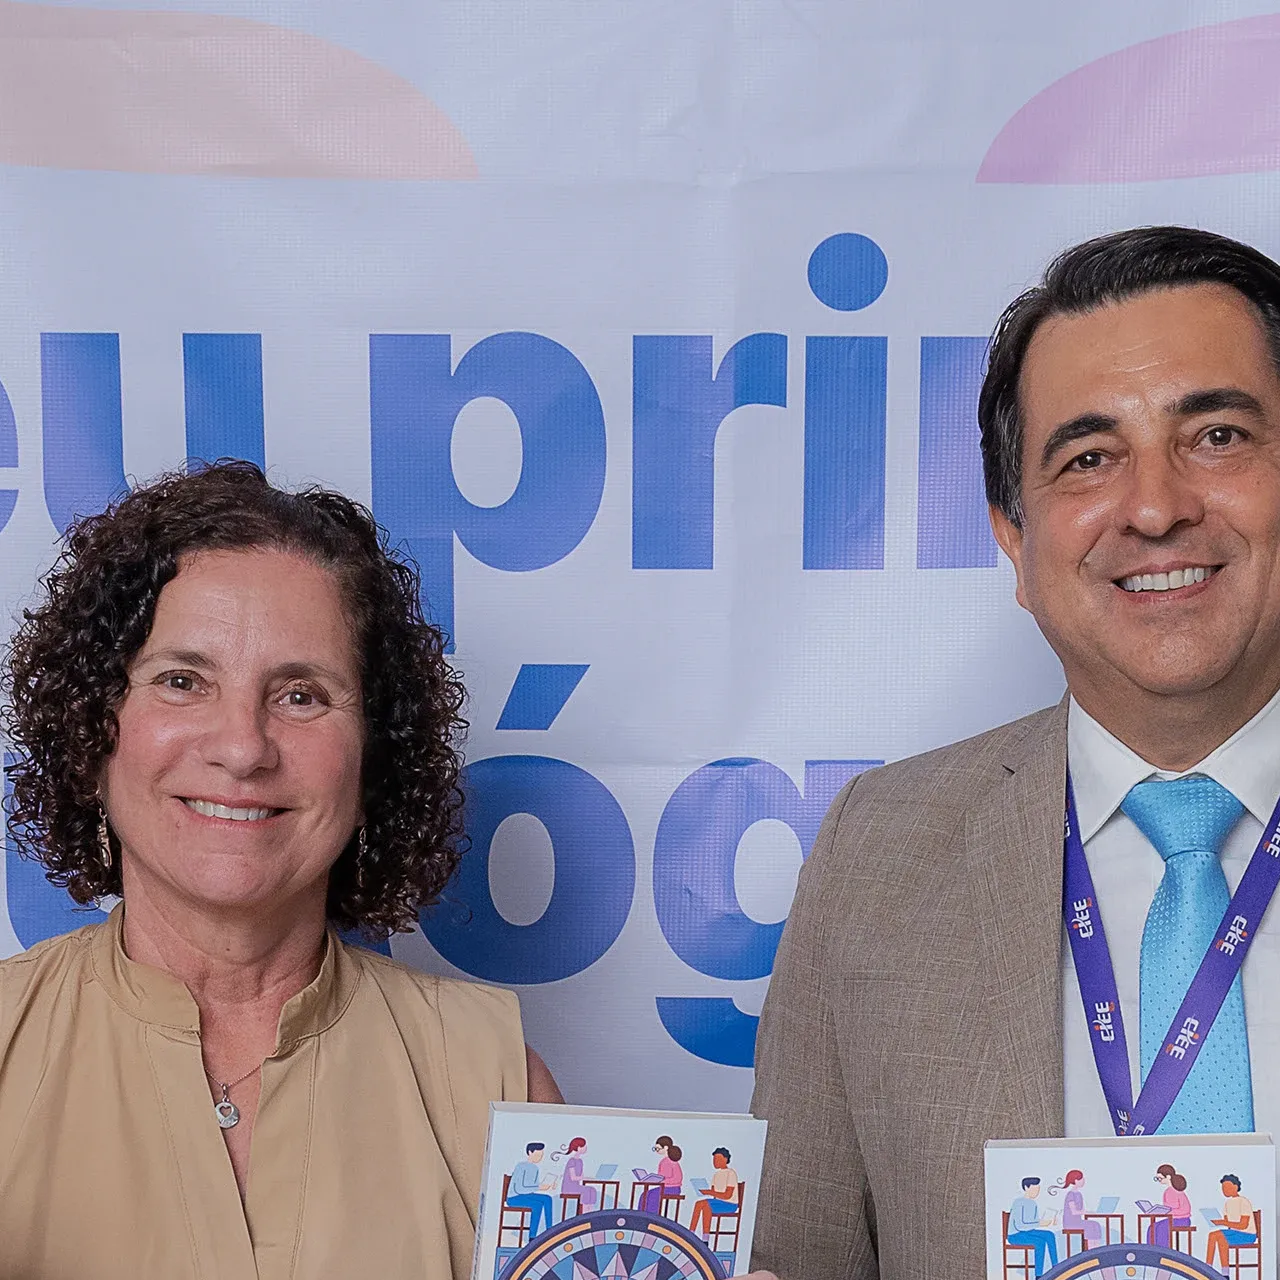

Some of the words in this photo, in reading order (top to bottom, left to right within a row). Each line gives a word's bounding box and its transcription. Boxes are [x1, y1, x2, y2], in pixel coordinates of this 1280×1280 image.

[1072, 898, 1094, 940] CIEE
[1220, 914, 1248, 956] CIEE
[1092, 1001, 1114, 1044] CIEE
[1170, 1016, 1199, 1060] CIEE
